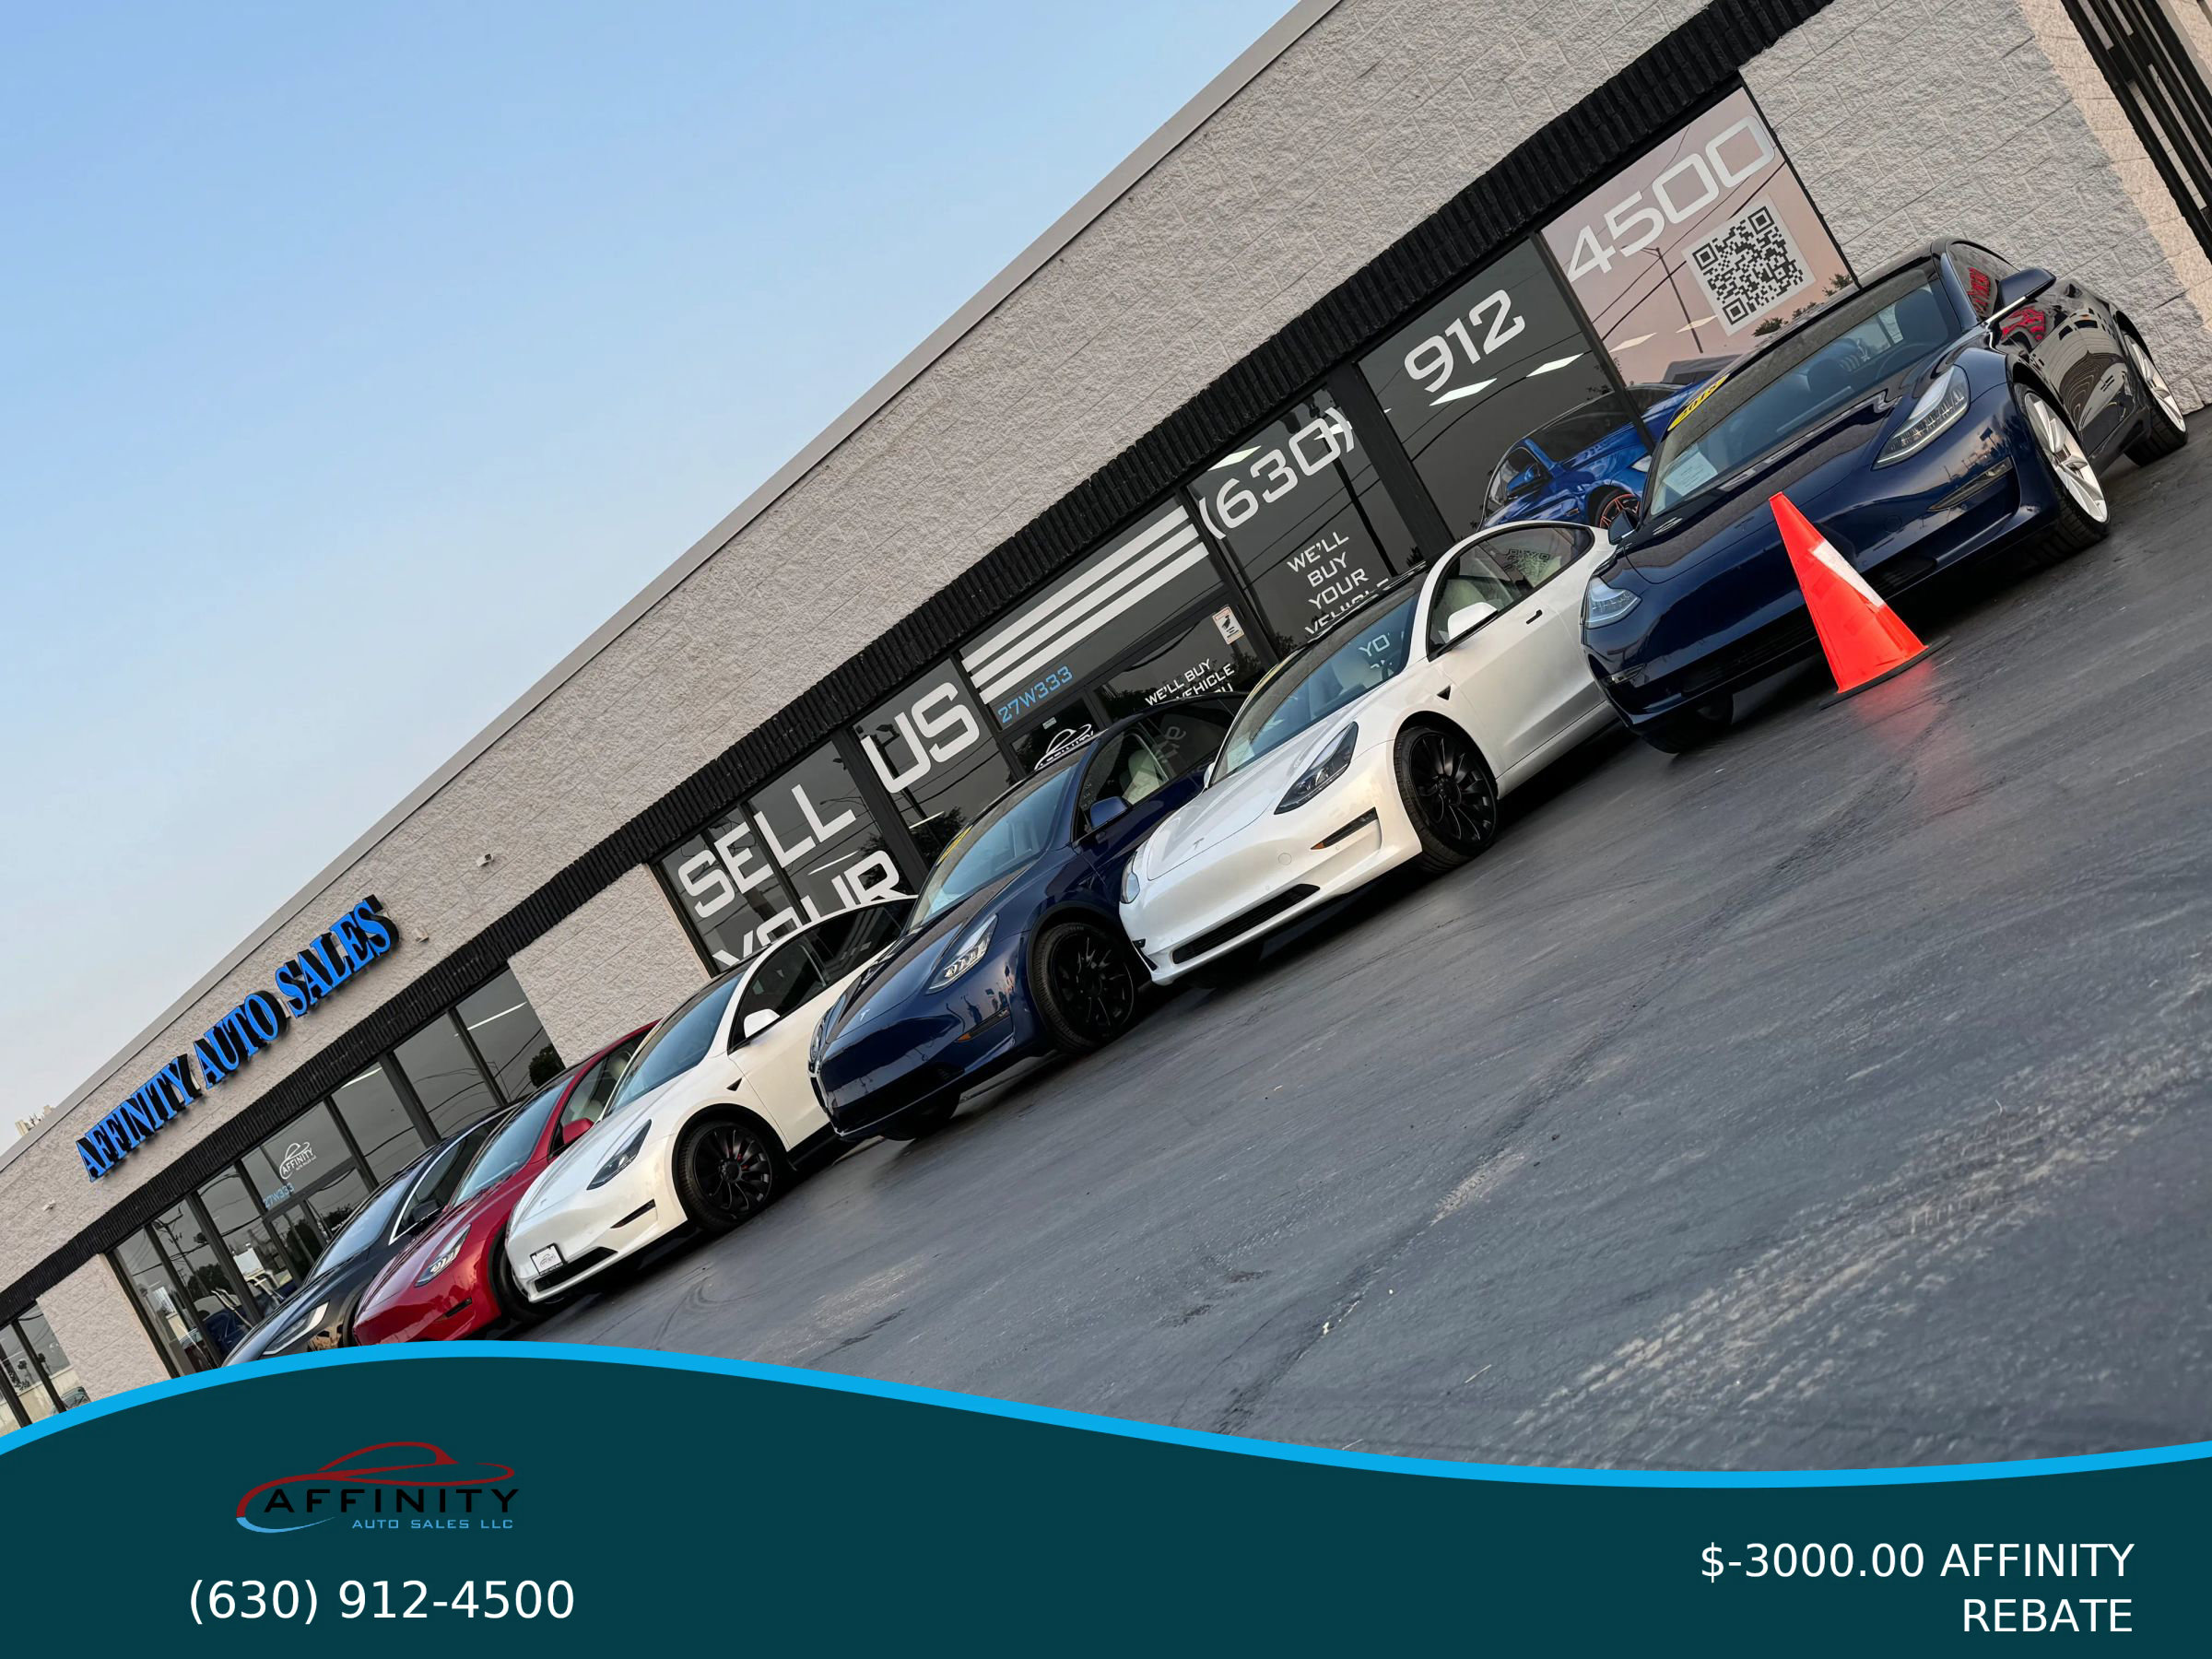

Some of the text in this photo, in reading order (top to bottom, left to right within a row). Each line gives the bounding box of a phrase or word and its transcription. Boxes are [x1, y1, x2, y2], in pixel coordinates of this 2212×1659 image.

[1199, 115, 1775, 539] (630) 912 4500
[1287, 532, 1349, 572] WE'LL
[1307, 552, 1347, 587] BUY
[1309, 568, 1369, 609] YOUR
[1359, 633, 1390, 657] YO
[998, 665, 1073, 724] 27W333
[1145, 658, 1211, 706] WE'LL BUY
[677, 682, 980, 918] SELL US
[76, 896, 396, 1183] AFFINITY AUTO SALES
[282, 1147, 314, 1175] AFFINITY
